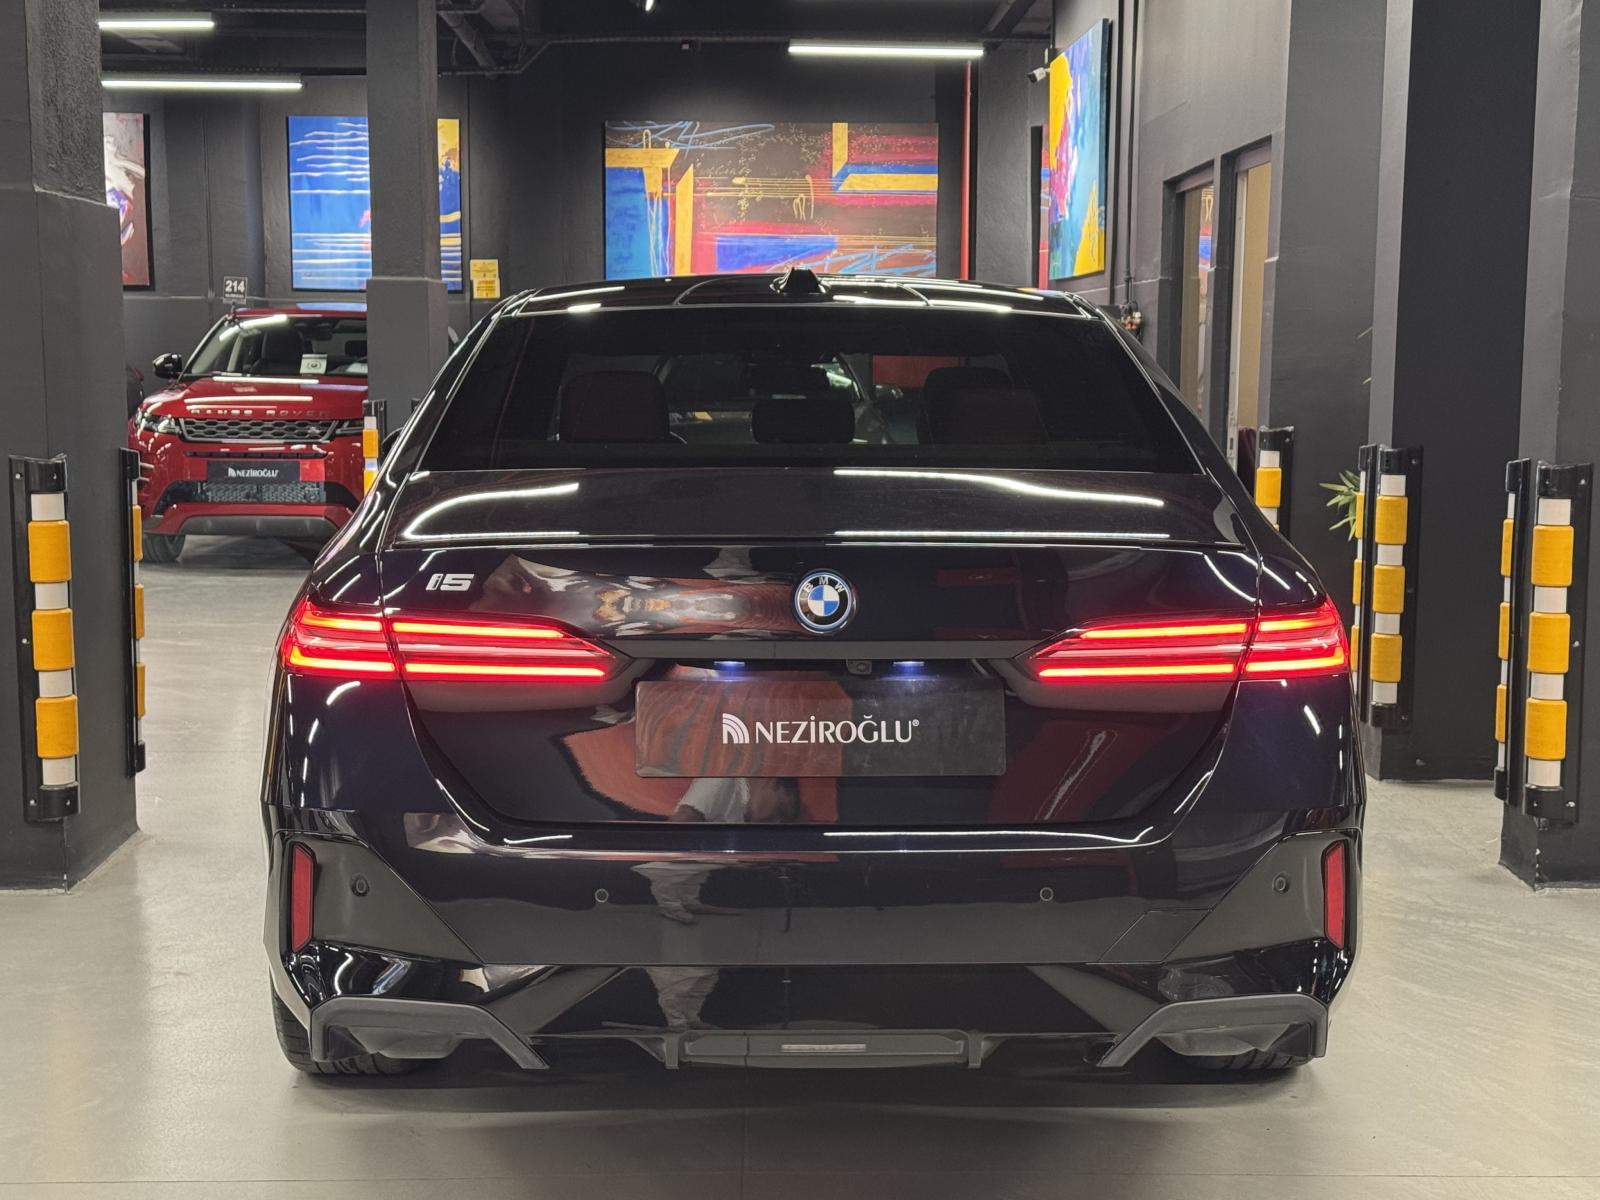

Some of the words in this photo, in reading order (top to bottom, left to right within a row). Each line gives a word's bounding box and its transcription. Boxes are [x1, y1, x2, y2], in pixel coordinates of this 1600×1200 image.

[225, 279, 245, 293] 214
[425, 573, 475, 591] i5
[803, 576, 845, 592] BMW
